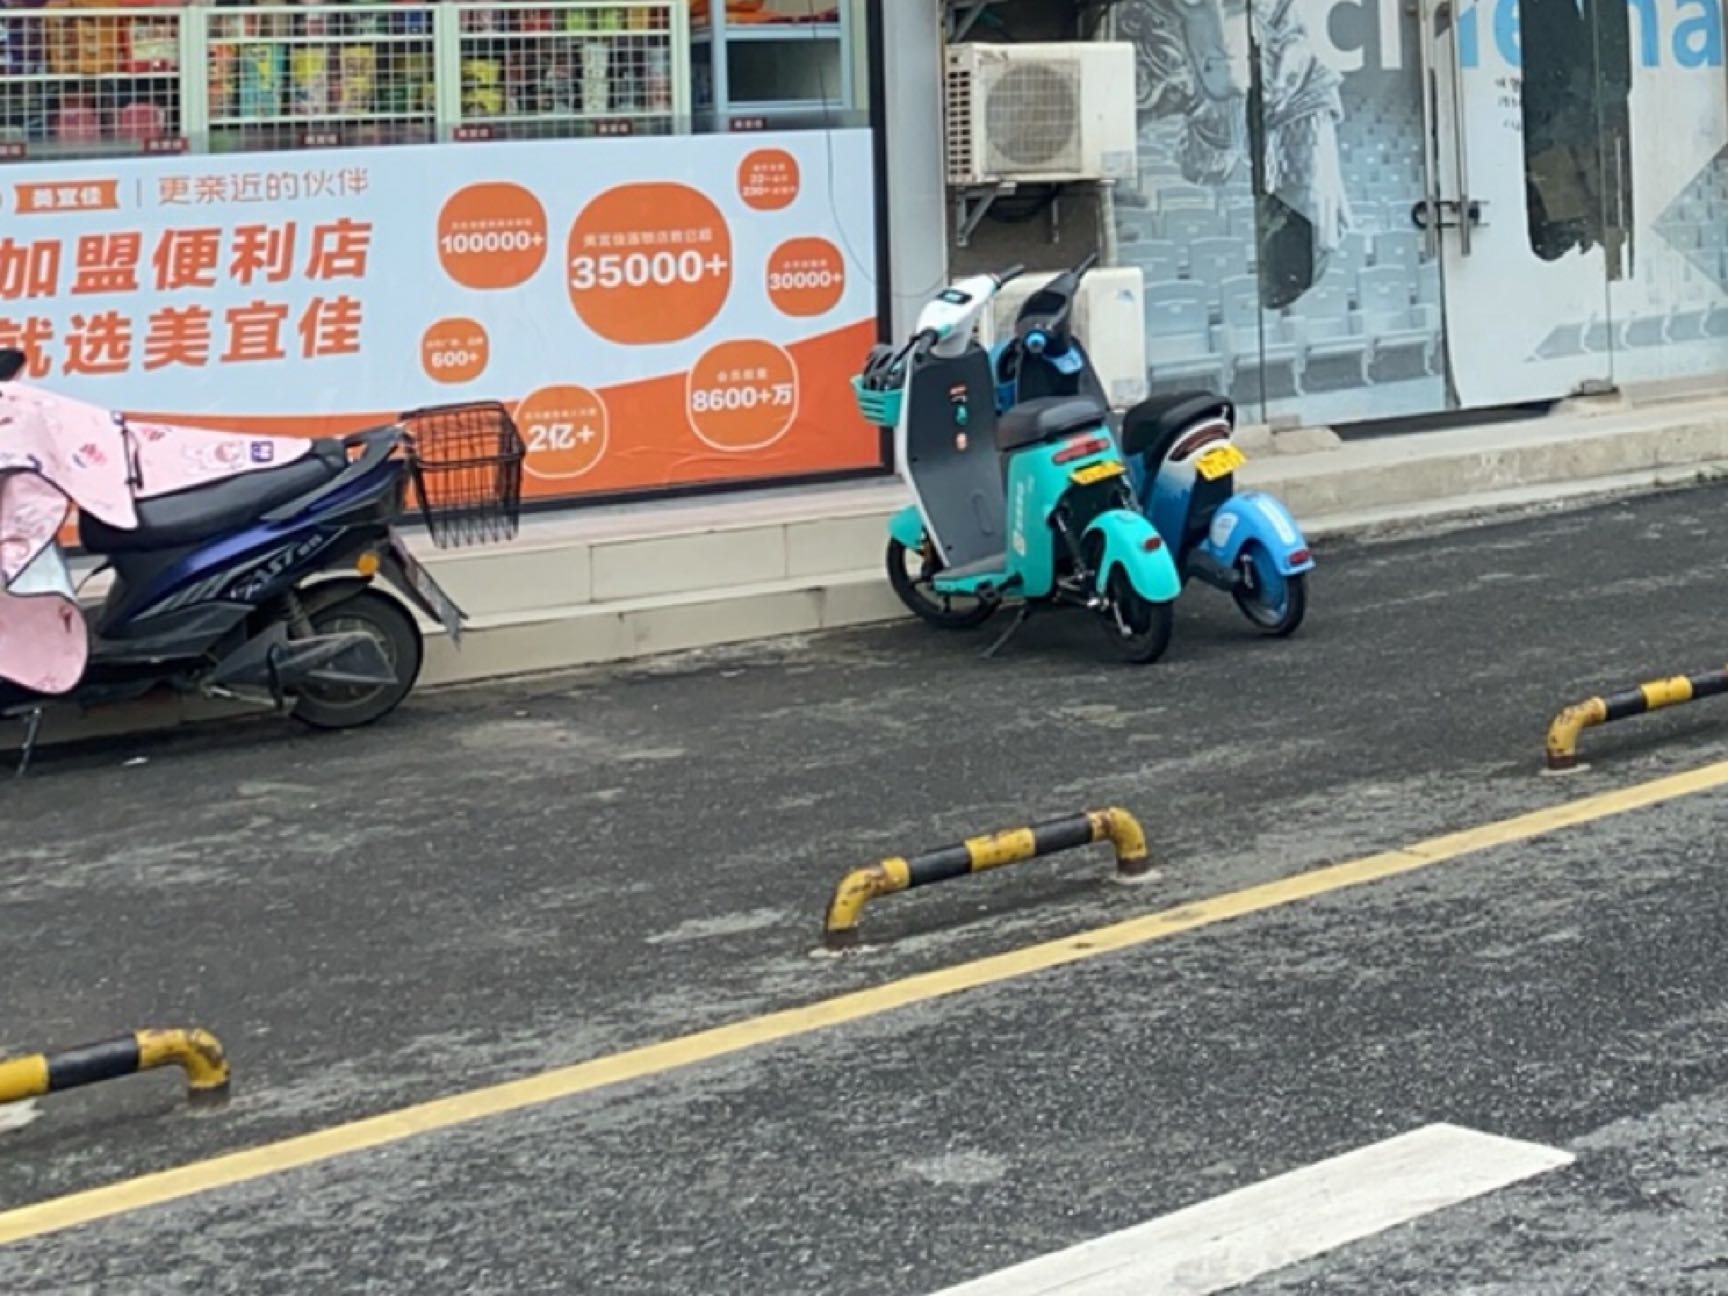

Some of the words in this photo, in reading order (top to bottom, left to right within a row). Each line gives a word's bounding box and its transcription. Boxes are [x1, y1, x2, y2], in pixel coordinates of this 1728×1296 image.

[158, 167, 370, 205] 更亲近的伙伴
[440, 230, 544, 253] 100000+
[0, 217, 373, 301] 加盟便利店
[570, 249, 729, 290] 35000+
[768, 270, 843, 290] 30000+
[0, 294, 363, 380] 就选美宜佳
[691, 382, 794, 413] 8600+万
[526, 423, 596, 454] 2亿+
